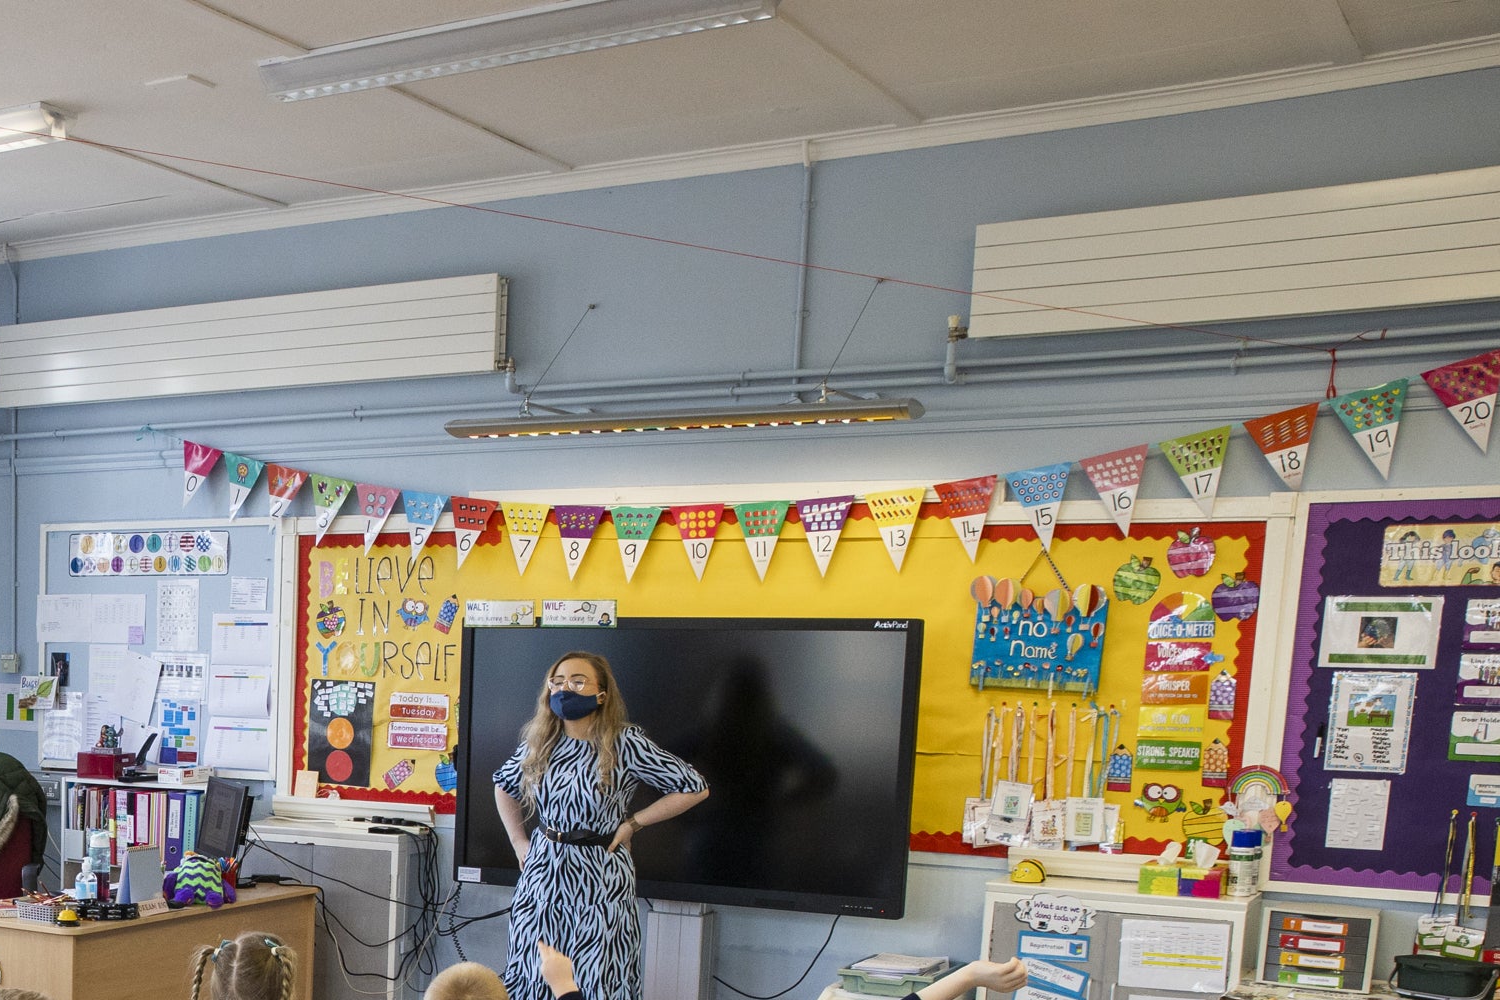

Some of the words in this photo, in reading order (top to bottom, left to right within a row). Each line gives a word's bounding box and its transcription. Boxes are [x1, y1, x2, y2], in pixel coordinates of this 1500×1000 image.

[1459, 402, 1490, 425] 20
[1368, 430, 1391, 452] 19
[1279, 451, 1300, 472] 18
[187, 476, 197, 491] 0
[1195, 473, 1212, 494] 17
[272, 501, 282, 517] 2
[1112, 491, 1131, 511] 16
[319, 511, 330, 528] 3
[1035, 507, 1052, 526] 15
[415, 527, 426, 545] 5
[962, 521, 979, 538] 14
[459, 533, 472, 551] 6
[815, 536, 832, 552] 12
[889, 530, 906, 547] 13
[519, 540, 531, 558] 7
[569, 541, 579, 560] 8
[614, 544, 626, 562] 9
[692, 542, 708, 559] 10
[756, 541, 767, 557] 11
[1386, 541, 1443, 560] This
[467, 603, 489, 612] WALT:
[544, 602, 566, 611] WILF:
[356, 599, 391, 636] IN
[1018, 620, 1047, 638] no
[399, 695, 423, 704] Today
[402, 708, 436, 717] Tuesday
[396, 736, 443, 744] Wednesday
[1137, 746, 1165, 757] STRONG
[1169, 747, 1199, 758] SPEAKER
[1034, 901, 1053, 909] What
[1035, 911, 1051, 921] doing
[1029, 942, 1064, 950] Registration
[1028, 990, 1052, 1000] Language
